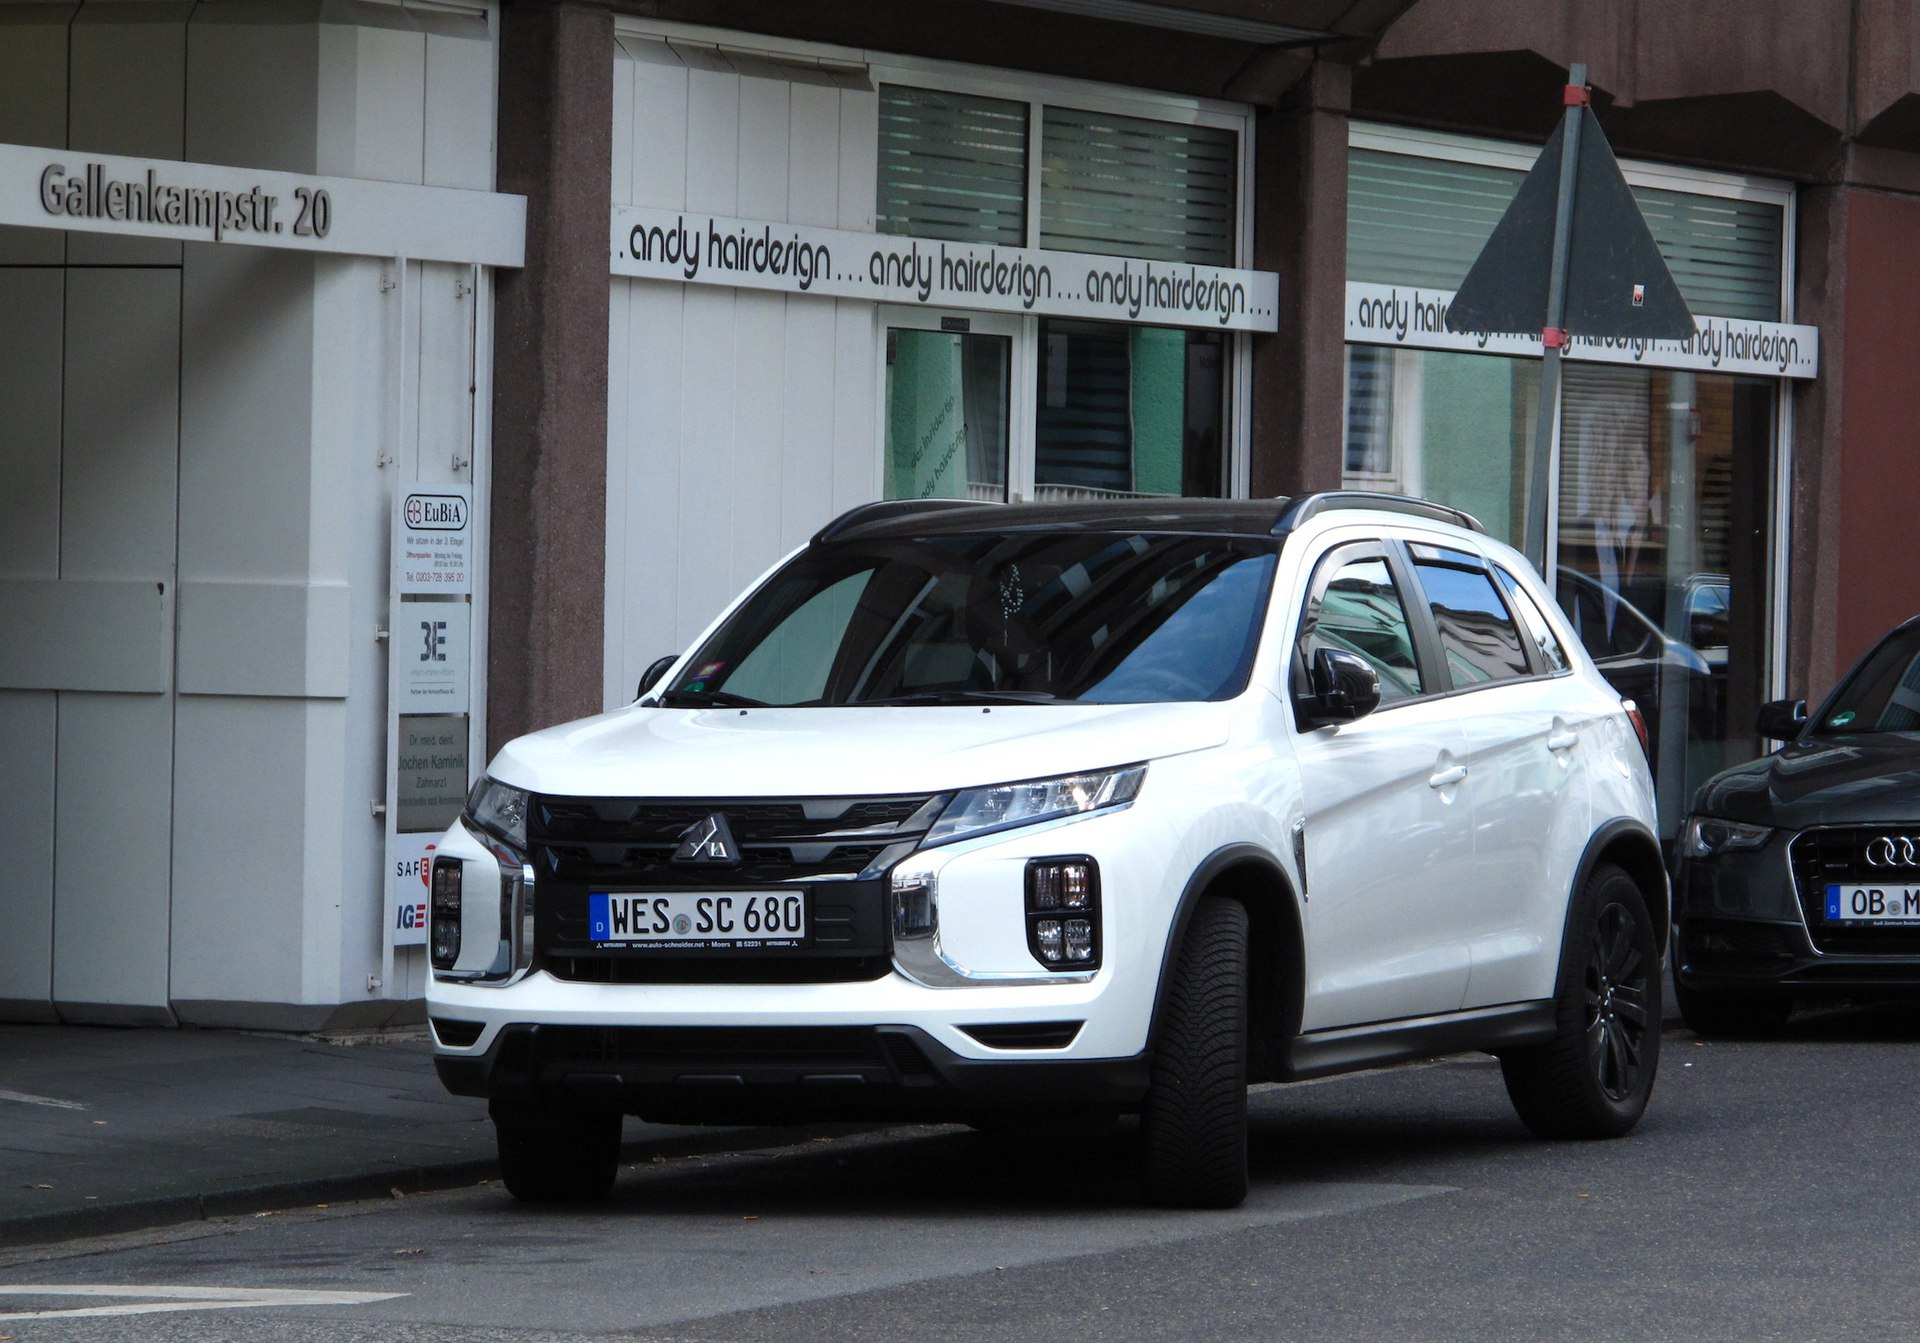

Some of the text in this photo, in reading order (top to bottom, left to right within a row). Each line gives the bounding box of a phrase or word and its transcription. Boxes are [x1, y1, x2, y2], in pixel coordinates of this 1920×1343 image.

[40, 163, 332, 241] Gallenkampstr. 20
[629, 216, 700, 280] andy
[869, 241, 932, 302] andy
[1086, 261, 1142, 319] andy
[1359, 289, 1408, 342] andy
[424, 502, 461, 522] EuBiA
[416, 776, 447, 788] Zahnarzt
[611, 897, 670, 934] WES
[696, 897, 734, 933] SC
[743, 896, 801, 932] 680
[1852, 889, 1886, 915] OB
